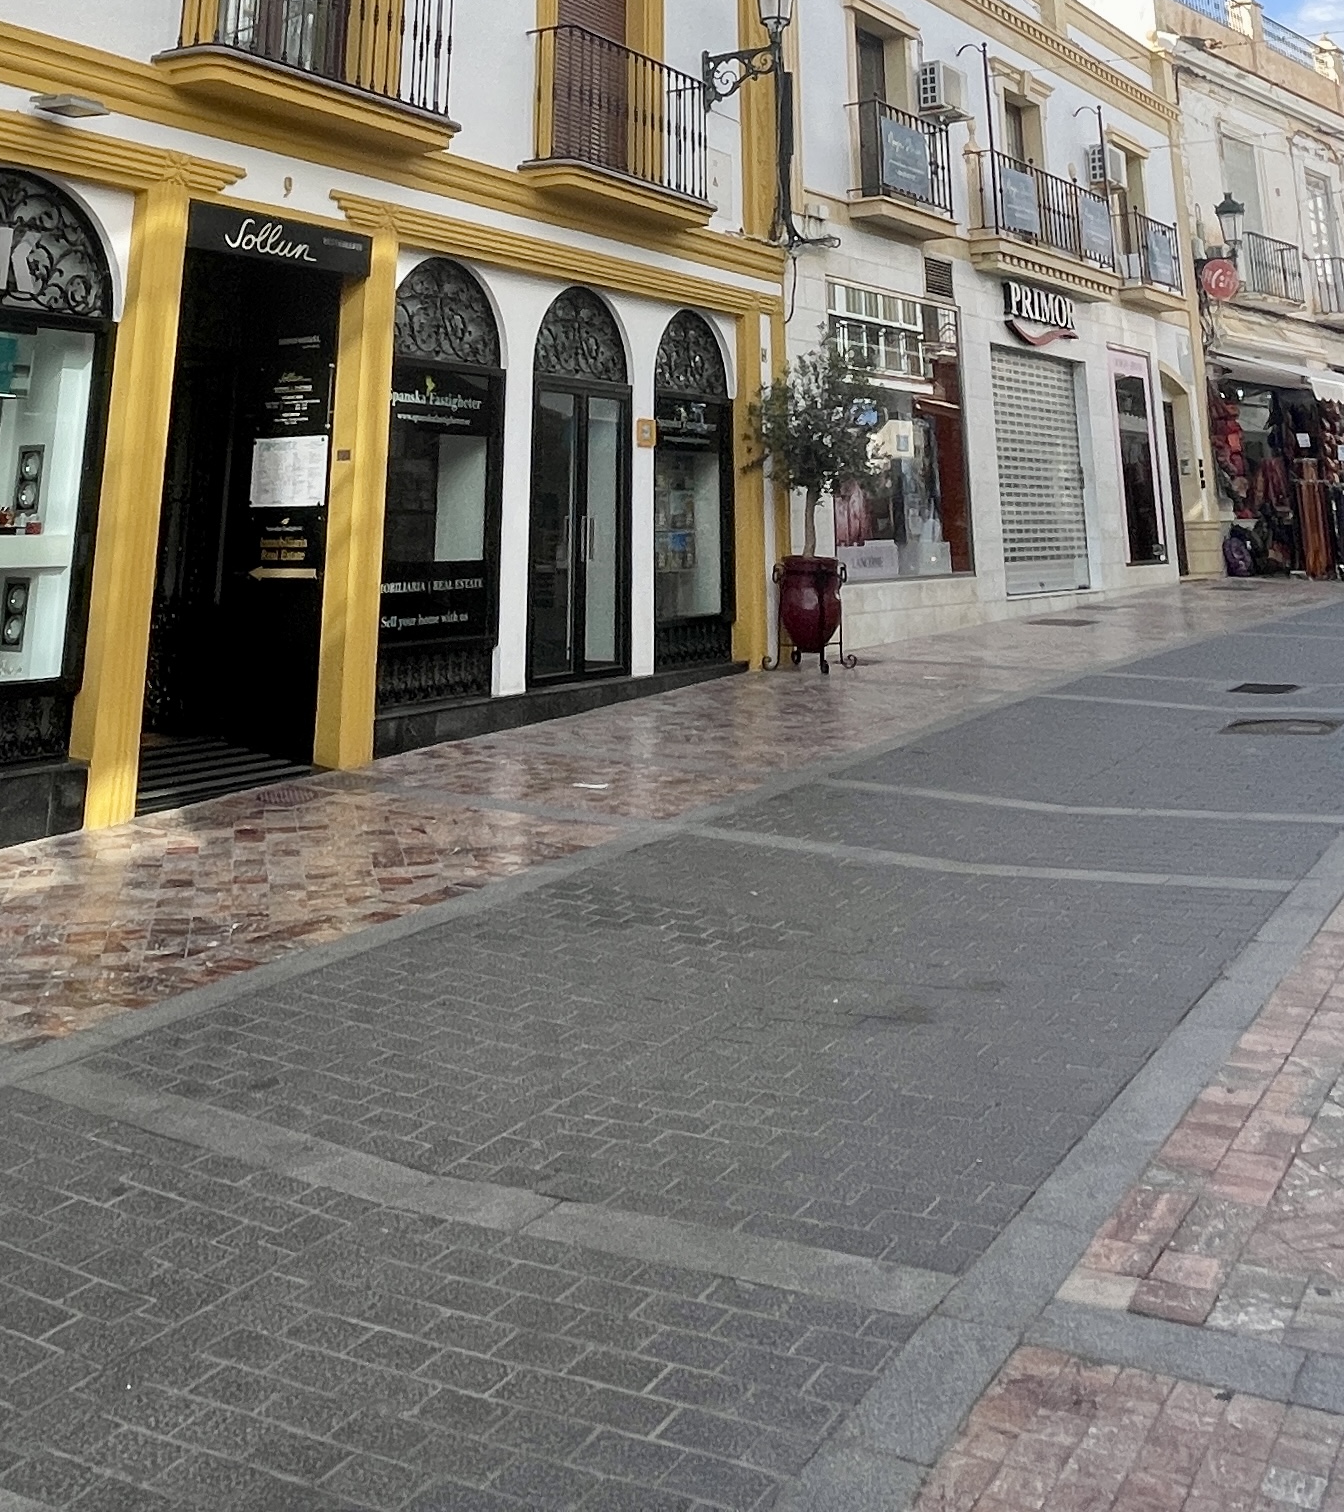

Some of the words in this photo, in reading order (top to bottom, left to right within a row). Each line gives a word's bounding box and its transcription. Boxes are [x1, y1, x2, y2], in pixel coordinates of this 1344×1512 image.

[283, 176, 293, 198] 9
[224, 218, 317, 262] Sollun
[1008, 282, 1076, 330] PRIMOR
